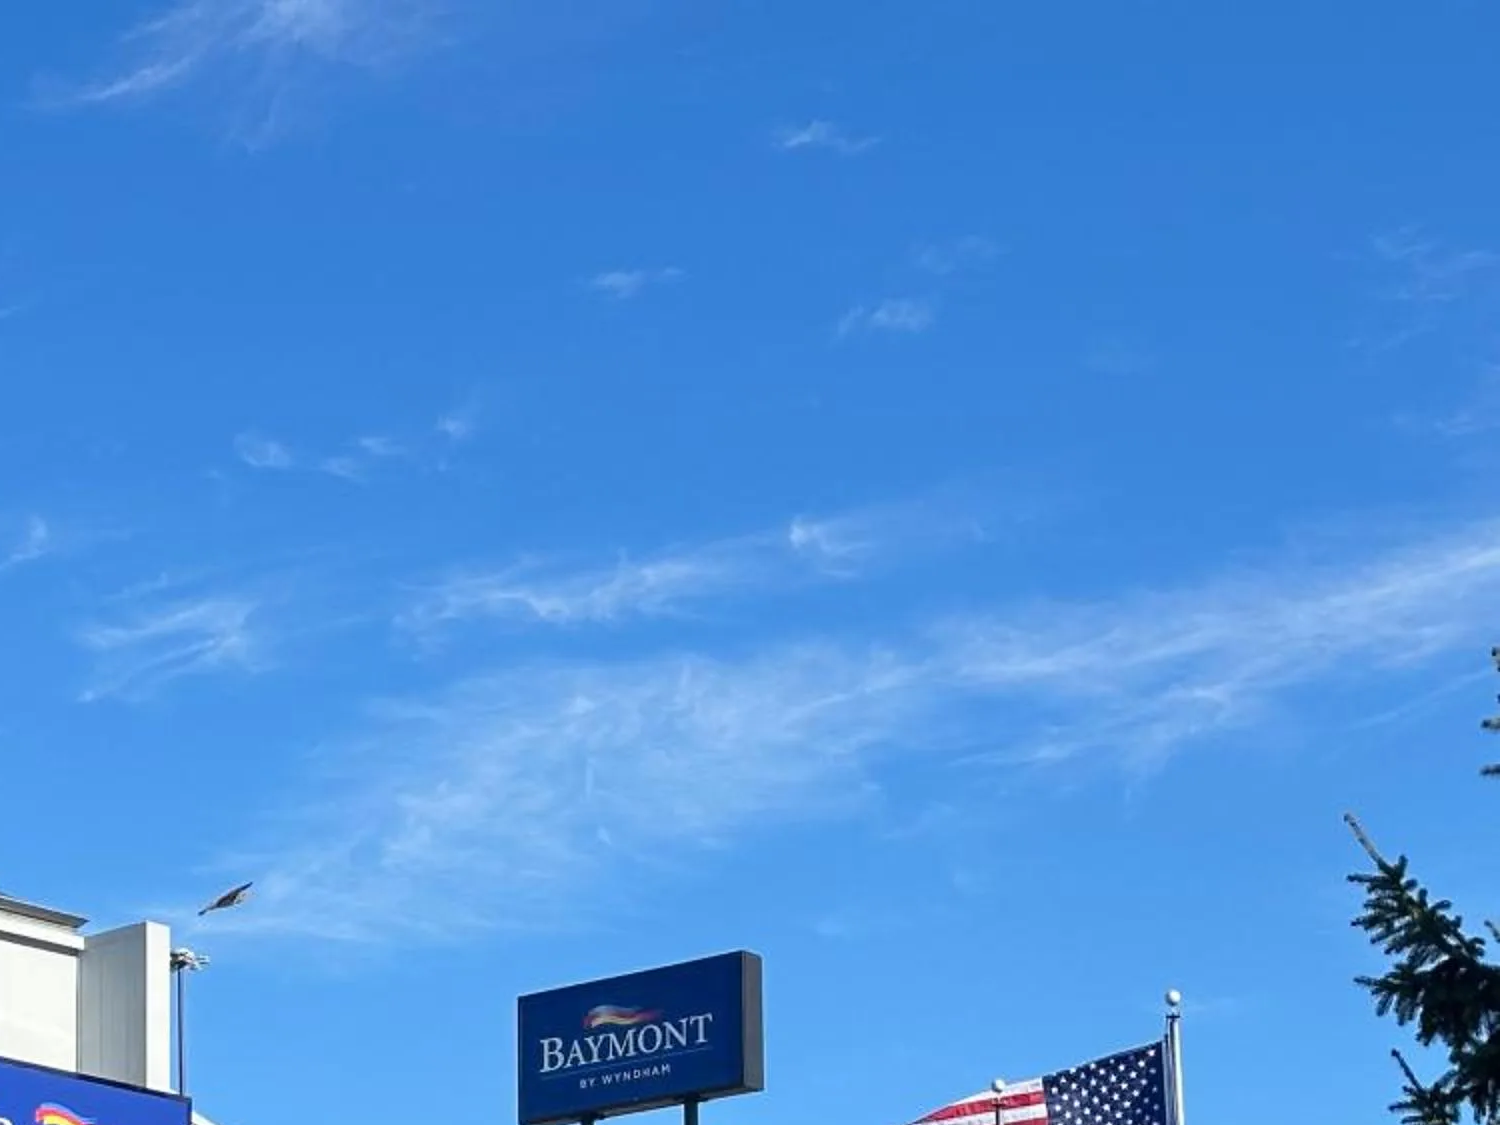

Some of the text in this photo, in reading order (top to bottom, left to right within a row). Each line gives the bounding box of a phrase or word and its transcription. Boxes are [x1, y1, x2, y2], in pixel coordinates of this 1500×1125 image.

[540, 1013, 713, 1073] BAYMONT
[579, 1063, 671, 1089] BY WYNDHAM
